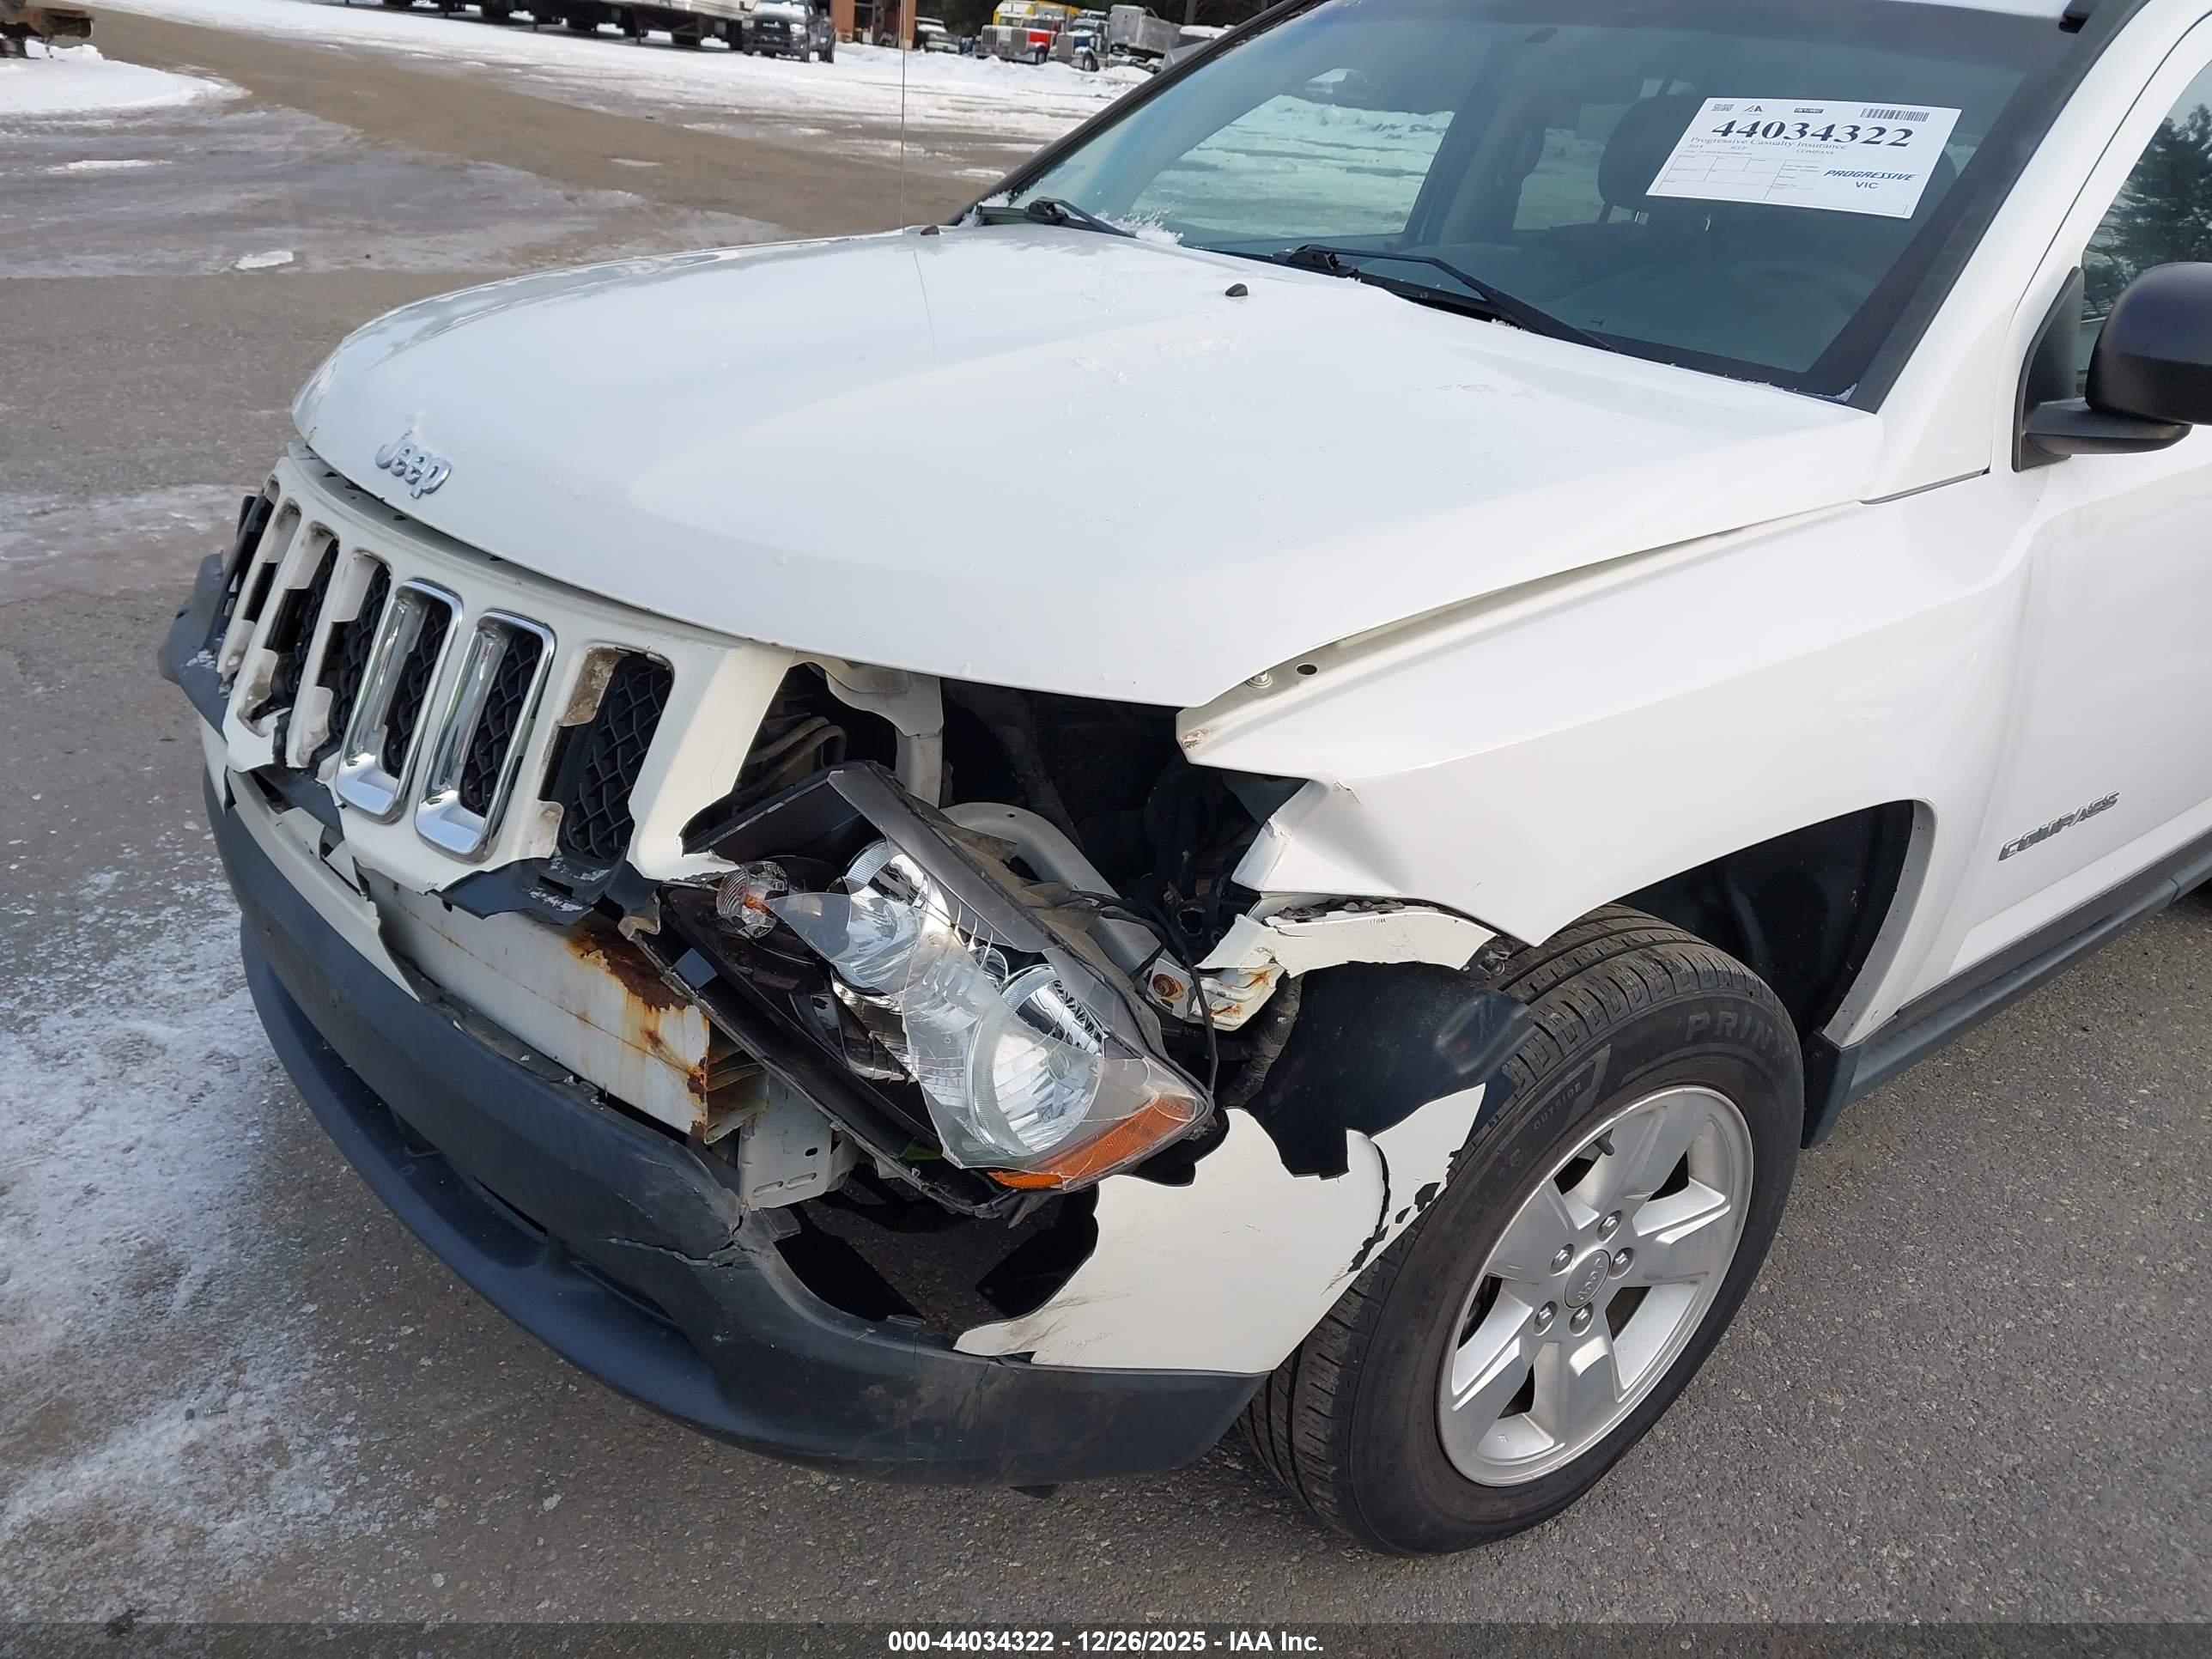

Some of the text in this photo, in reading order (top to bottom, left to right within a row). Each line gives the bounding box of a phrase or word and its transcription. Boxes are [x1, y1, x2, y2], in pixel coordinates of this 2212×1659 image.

[1711, 119, 1914, 147] 44034322
[1750, 138, 1793, 147] Casualty
[1796, 141, 1847, 149] Insurance
[1823, 169, 1917, 181] PROGRESSIVE
[1856, 181, 1880, 190] VIC
[374, 429, 453, 500] Jeep
[1997, 790, 2120, 862] COMPASS
